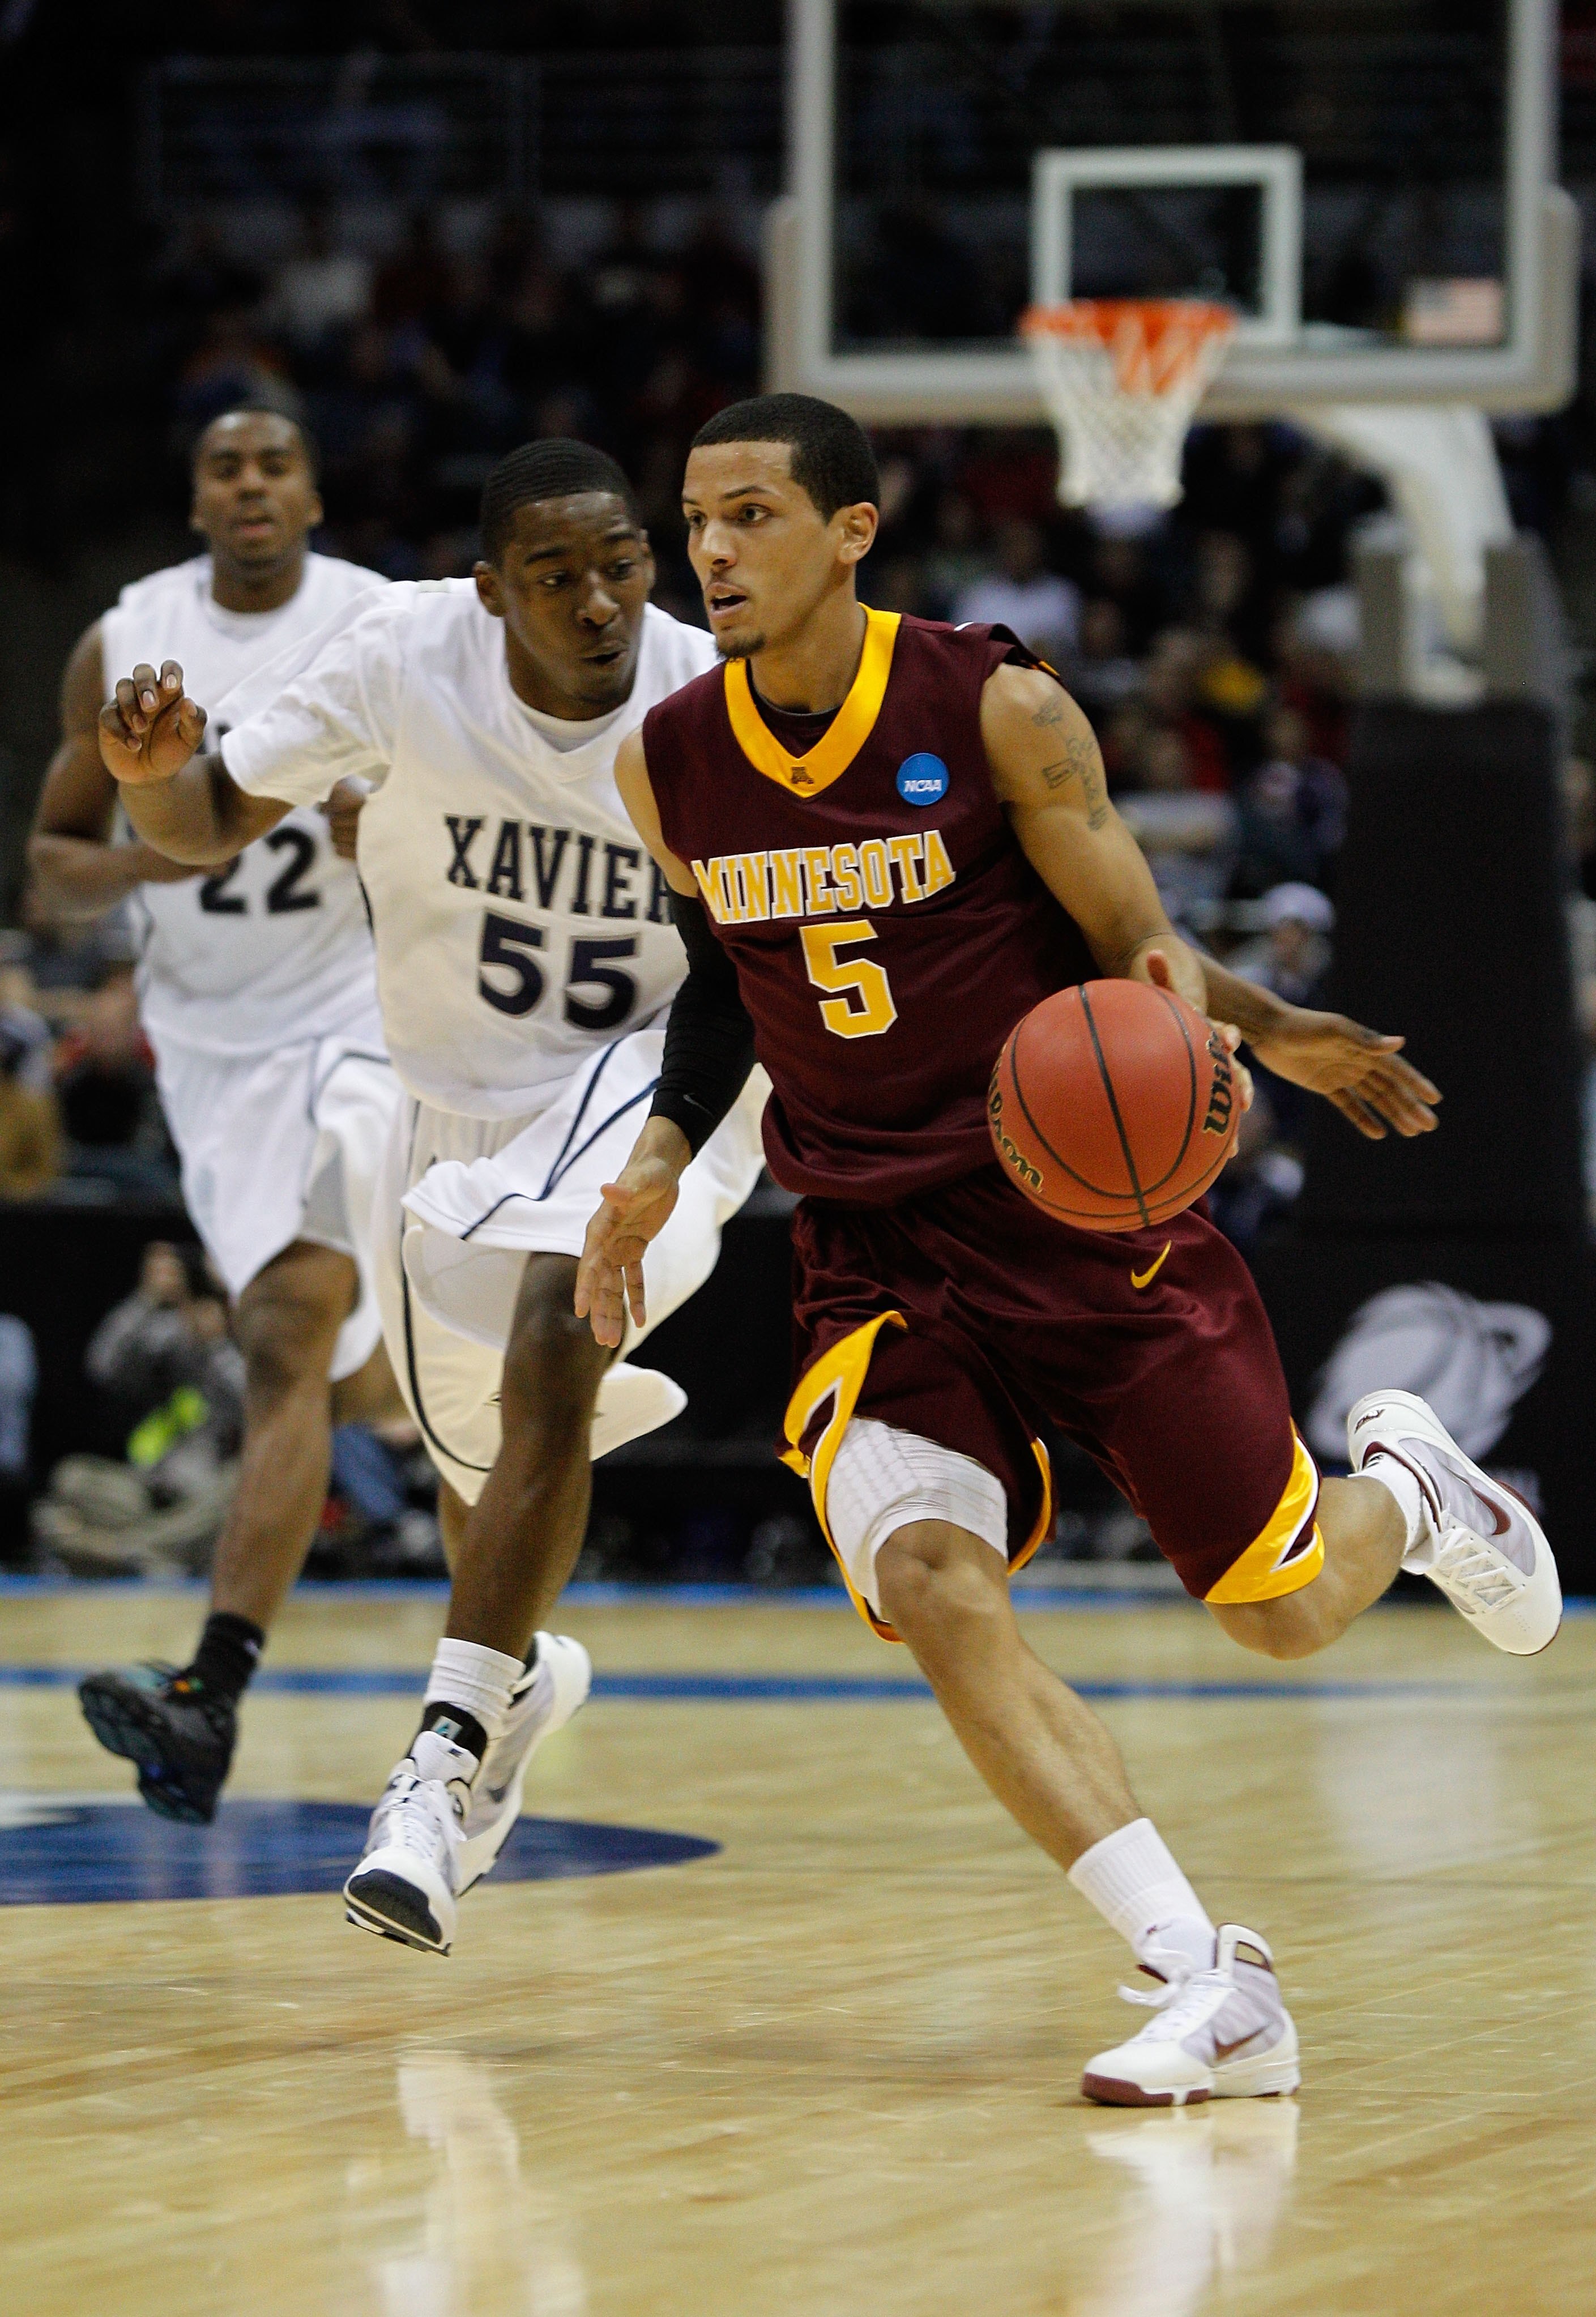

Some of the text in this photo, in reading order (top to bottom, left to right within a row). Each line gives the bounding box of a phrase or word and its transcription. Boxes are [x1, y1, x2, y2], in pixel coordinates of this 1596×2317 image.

[904, 779, 942, 793] NCAA
[198, 825, 321, 915] 22
[691, 829, 957, 924] MINNESOTA
[476, 906, 641, 1030] 55
[799, 919, 898, 1039] 5
